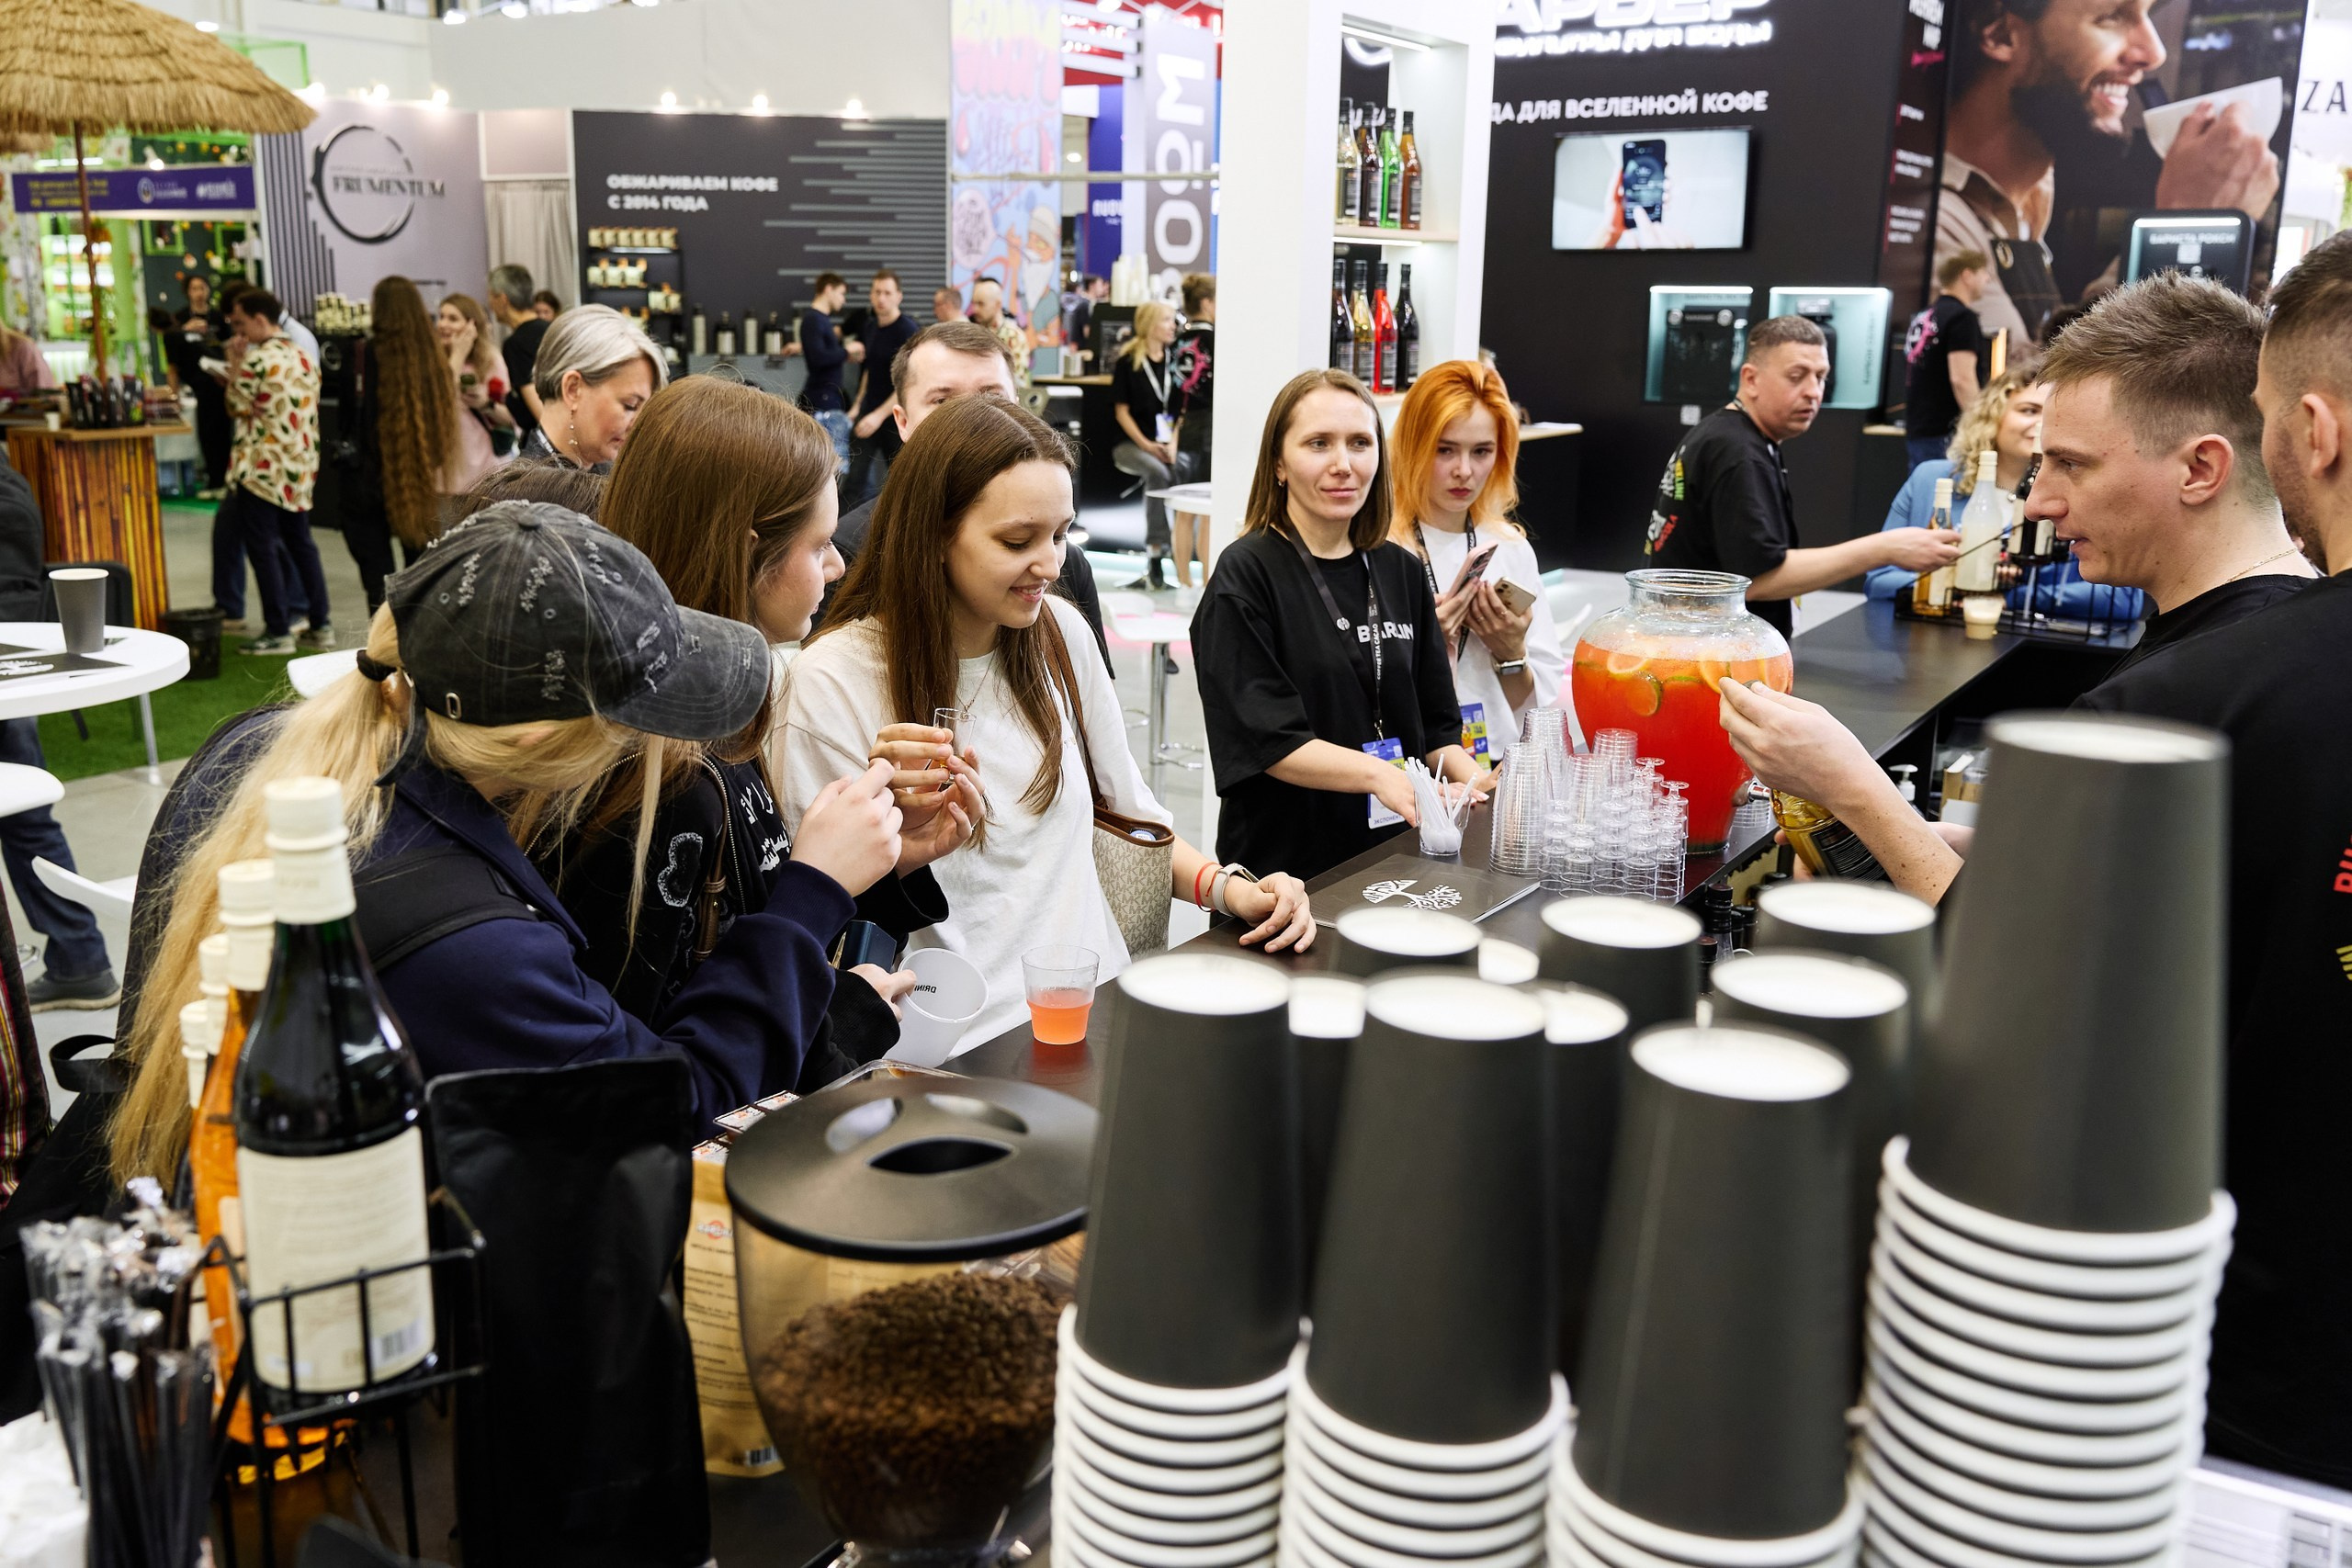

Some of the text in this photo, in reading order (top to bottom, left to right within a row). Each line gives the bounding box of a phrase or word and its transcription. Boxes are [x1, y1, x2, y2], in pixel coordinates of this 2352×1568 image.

[1517, 99, 1562, 123] ДЛЯ
[1565, 88, 1698, 119] ВСЕЛЕННОЙ
[1702, 90, 1769, 113] КОФЕ
[333, 175, 446, 197] FRUMENTUM
[605, 174, 779, 192] ОБЖАРИВАЕМ КОФЕ
[606, 194, 621, 209] С
[662, 196, 710, 212] ГОДА
[1372, 623, 1381, 645] CACAO
